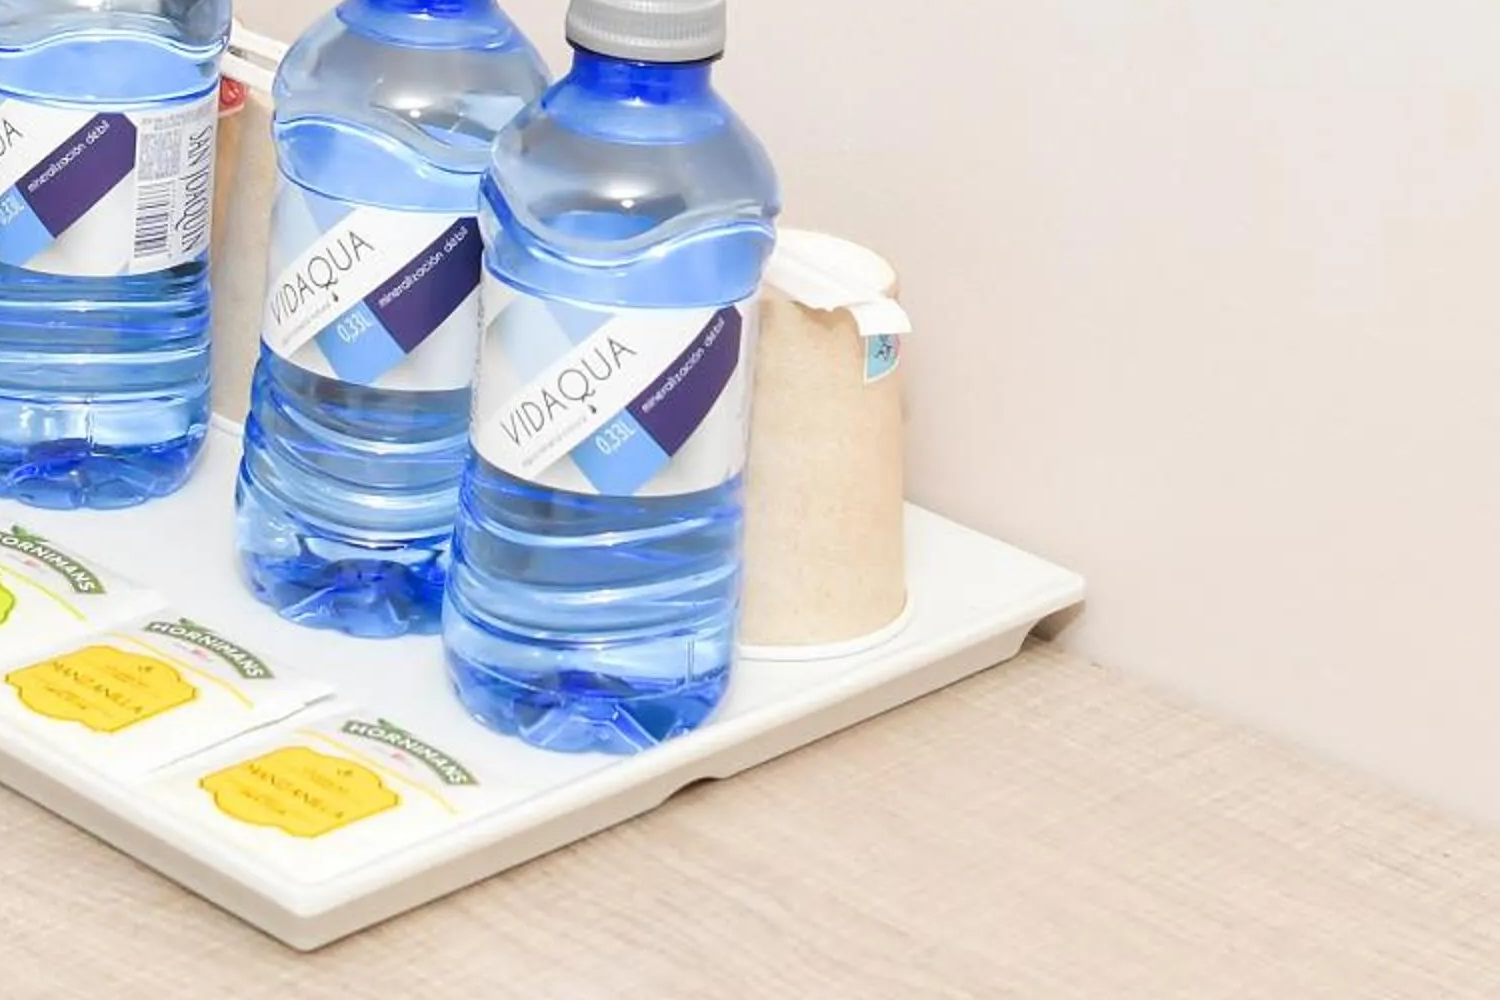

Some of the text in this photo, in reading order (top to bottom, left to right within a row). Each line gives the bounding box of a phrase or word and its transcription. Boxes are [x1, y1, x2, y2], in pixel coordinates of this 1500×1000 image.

[176, 125, 213, 253] SAN JOAQUIN
[270, 230, 375, 325] VIDAQUA
[378, 250, 444, 309] mineralización
[336, 310, 374, 344] 0,33L
[500, 337, 637, 447] VIDAQUA
[594, 421, 637, 456] 0,33L
[151, 622, 266, 678] HORNIMANS
[349, 721, 469, 784] HORNIMANS
